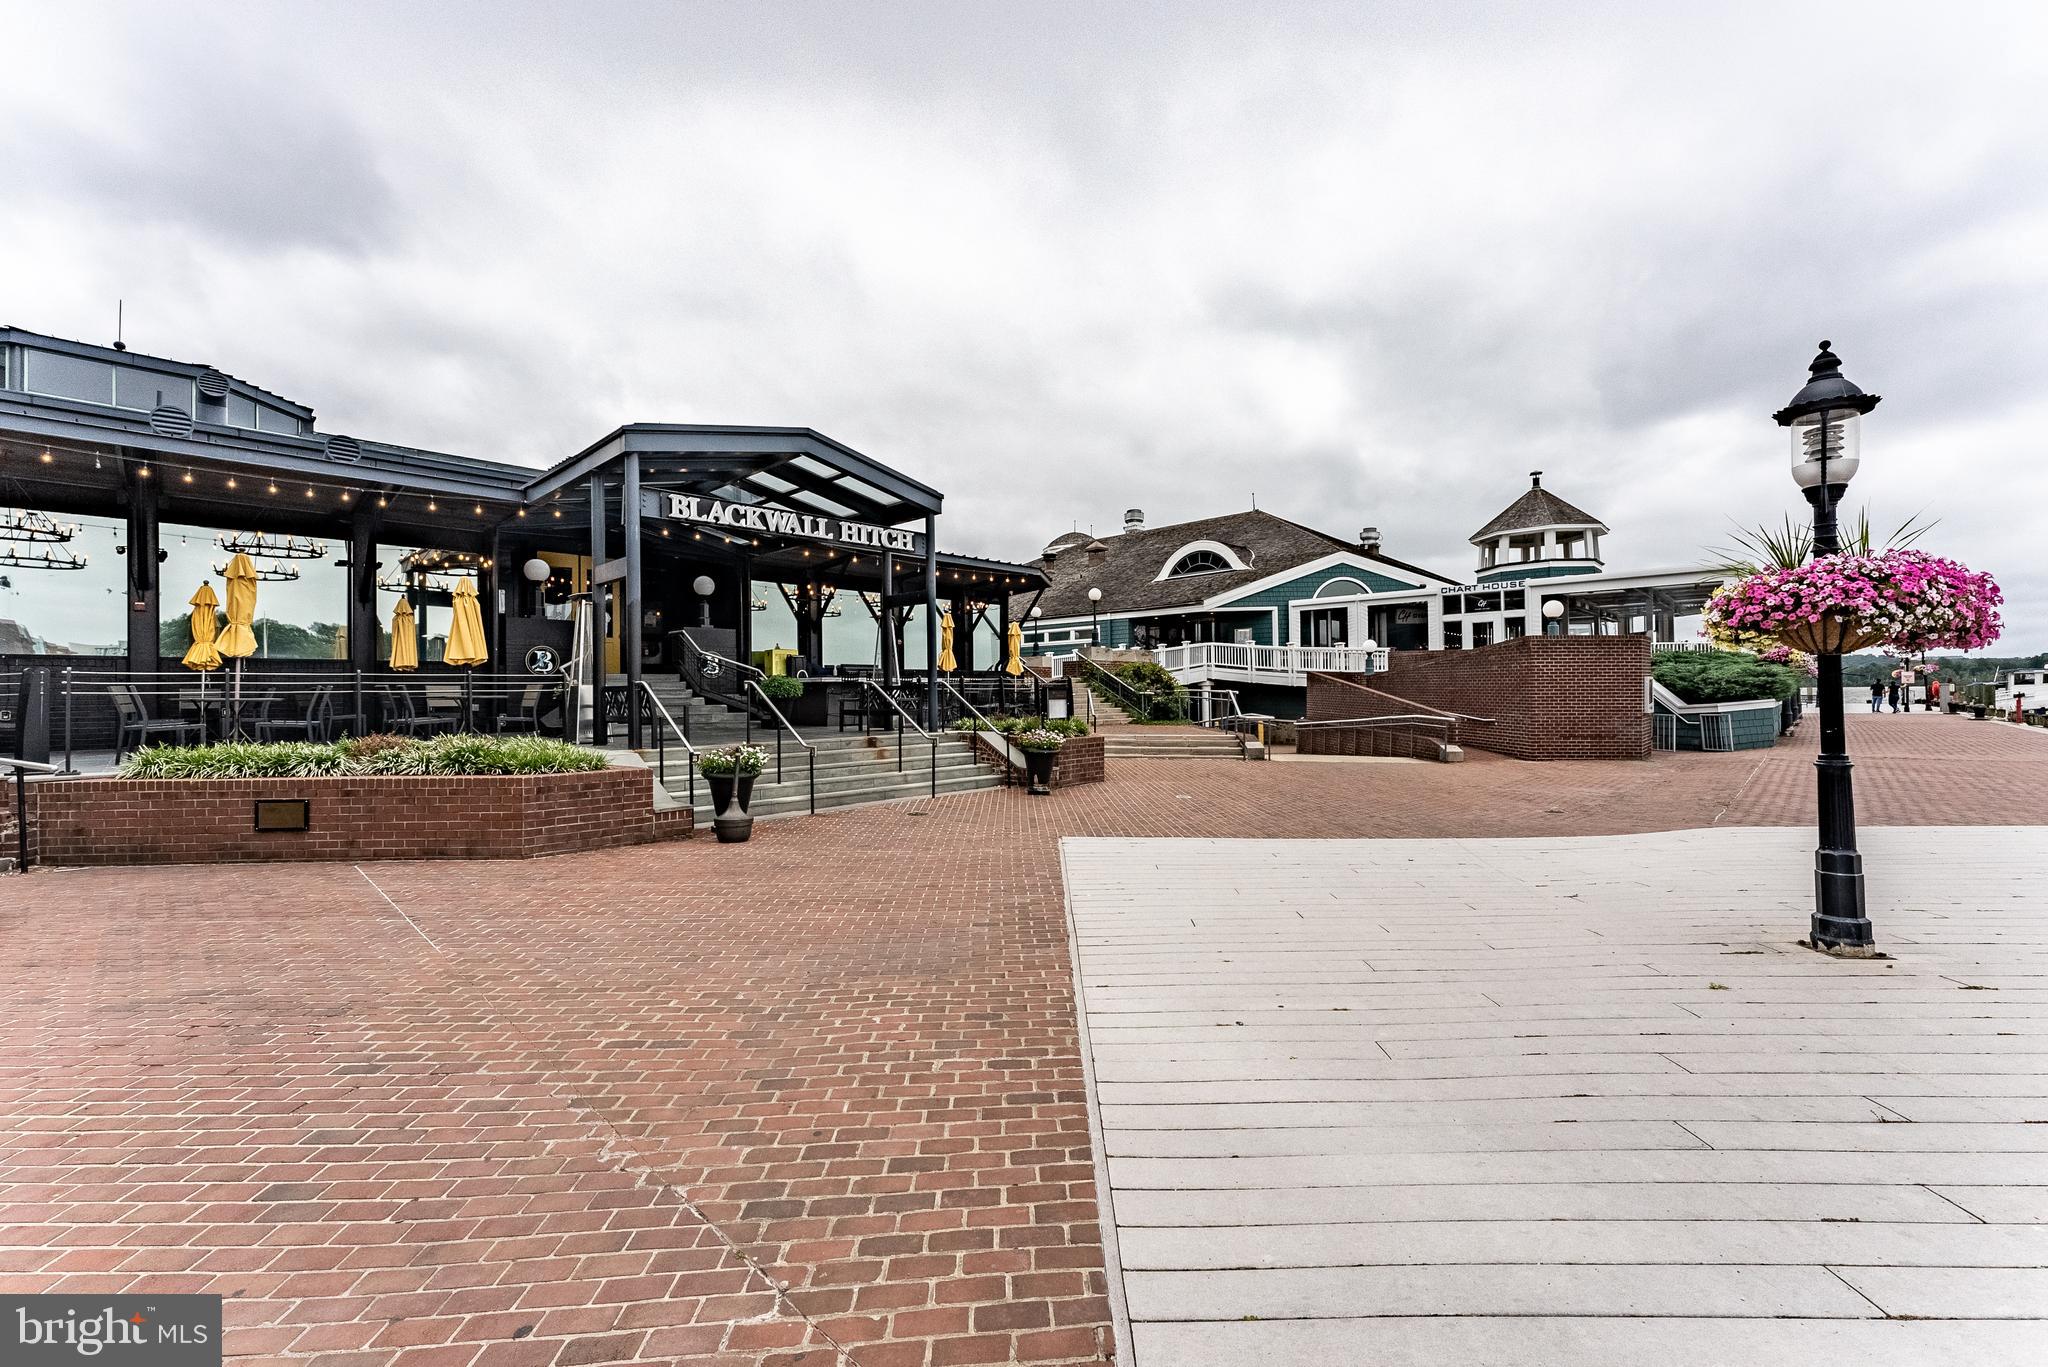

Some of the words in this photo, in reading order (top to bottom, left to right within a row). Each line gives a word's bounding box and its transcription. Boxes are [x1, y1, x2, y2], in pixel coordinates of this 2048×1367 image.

[668, 493, 834, 540] BLACKWALL
[839, 521, 915, 551] HITCH
[1440, 584, 1479, 594] CHART
[1482, 580, 1526, 591] HOUSE
